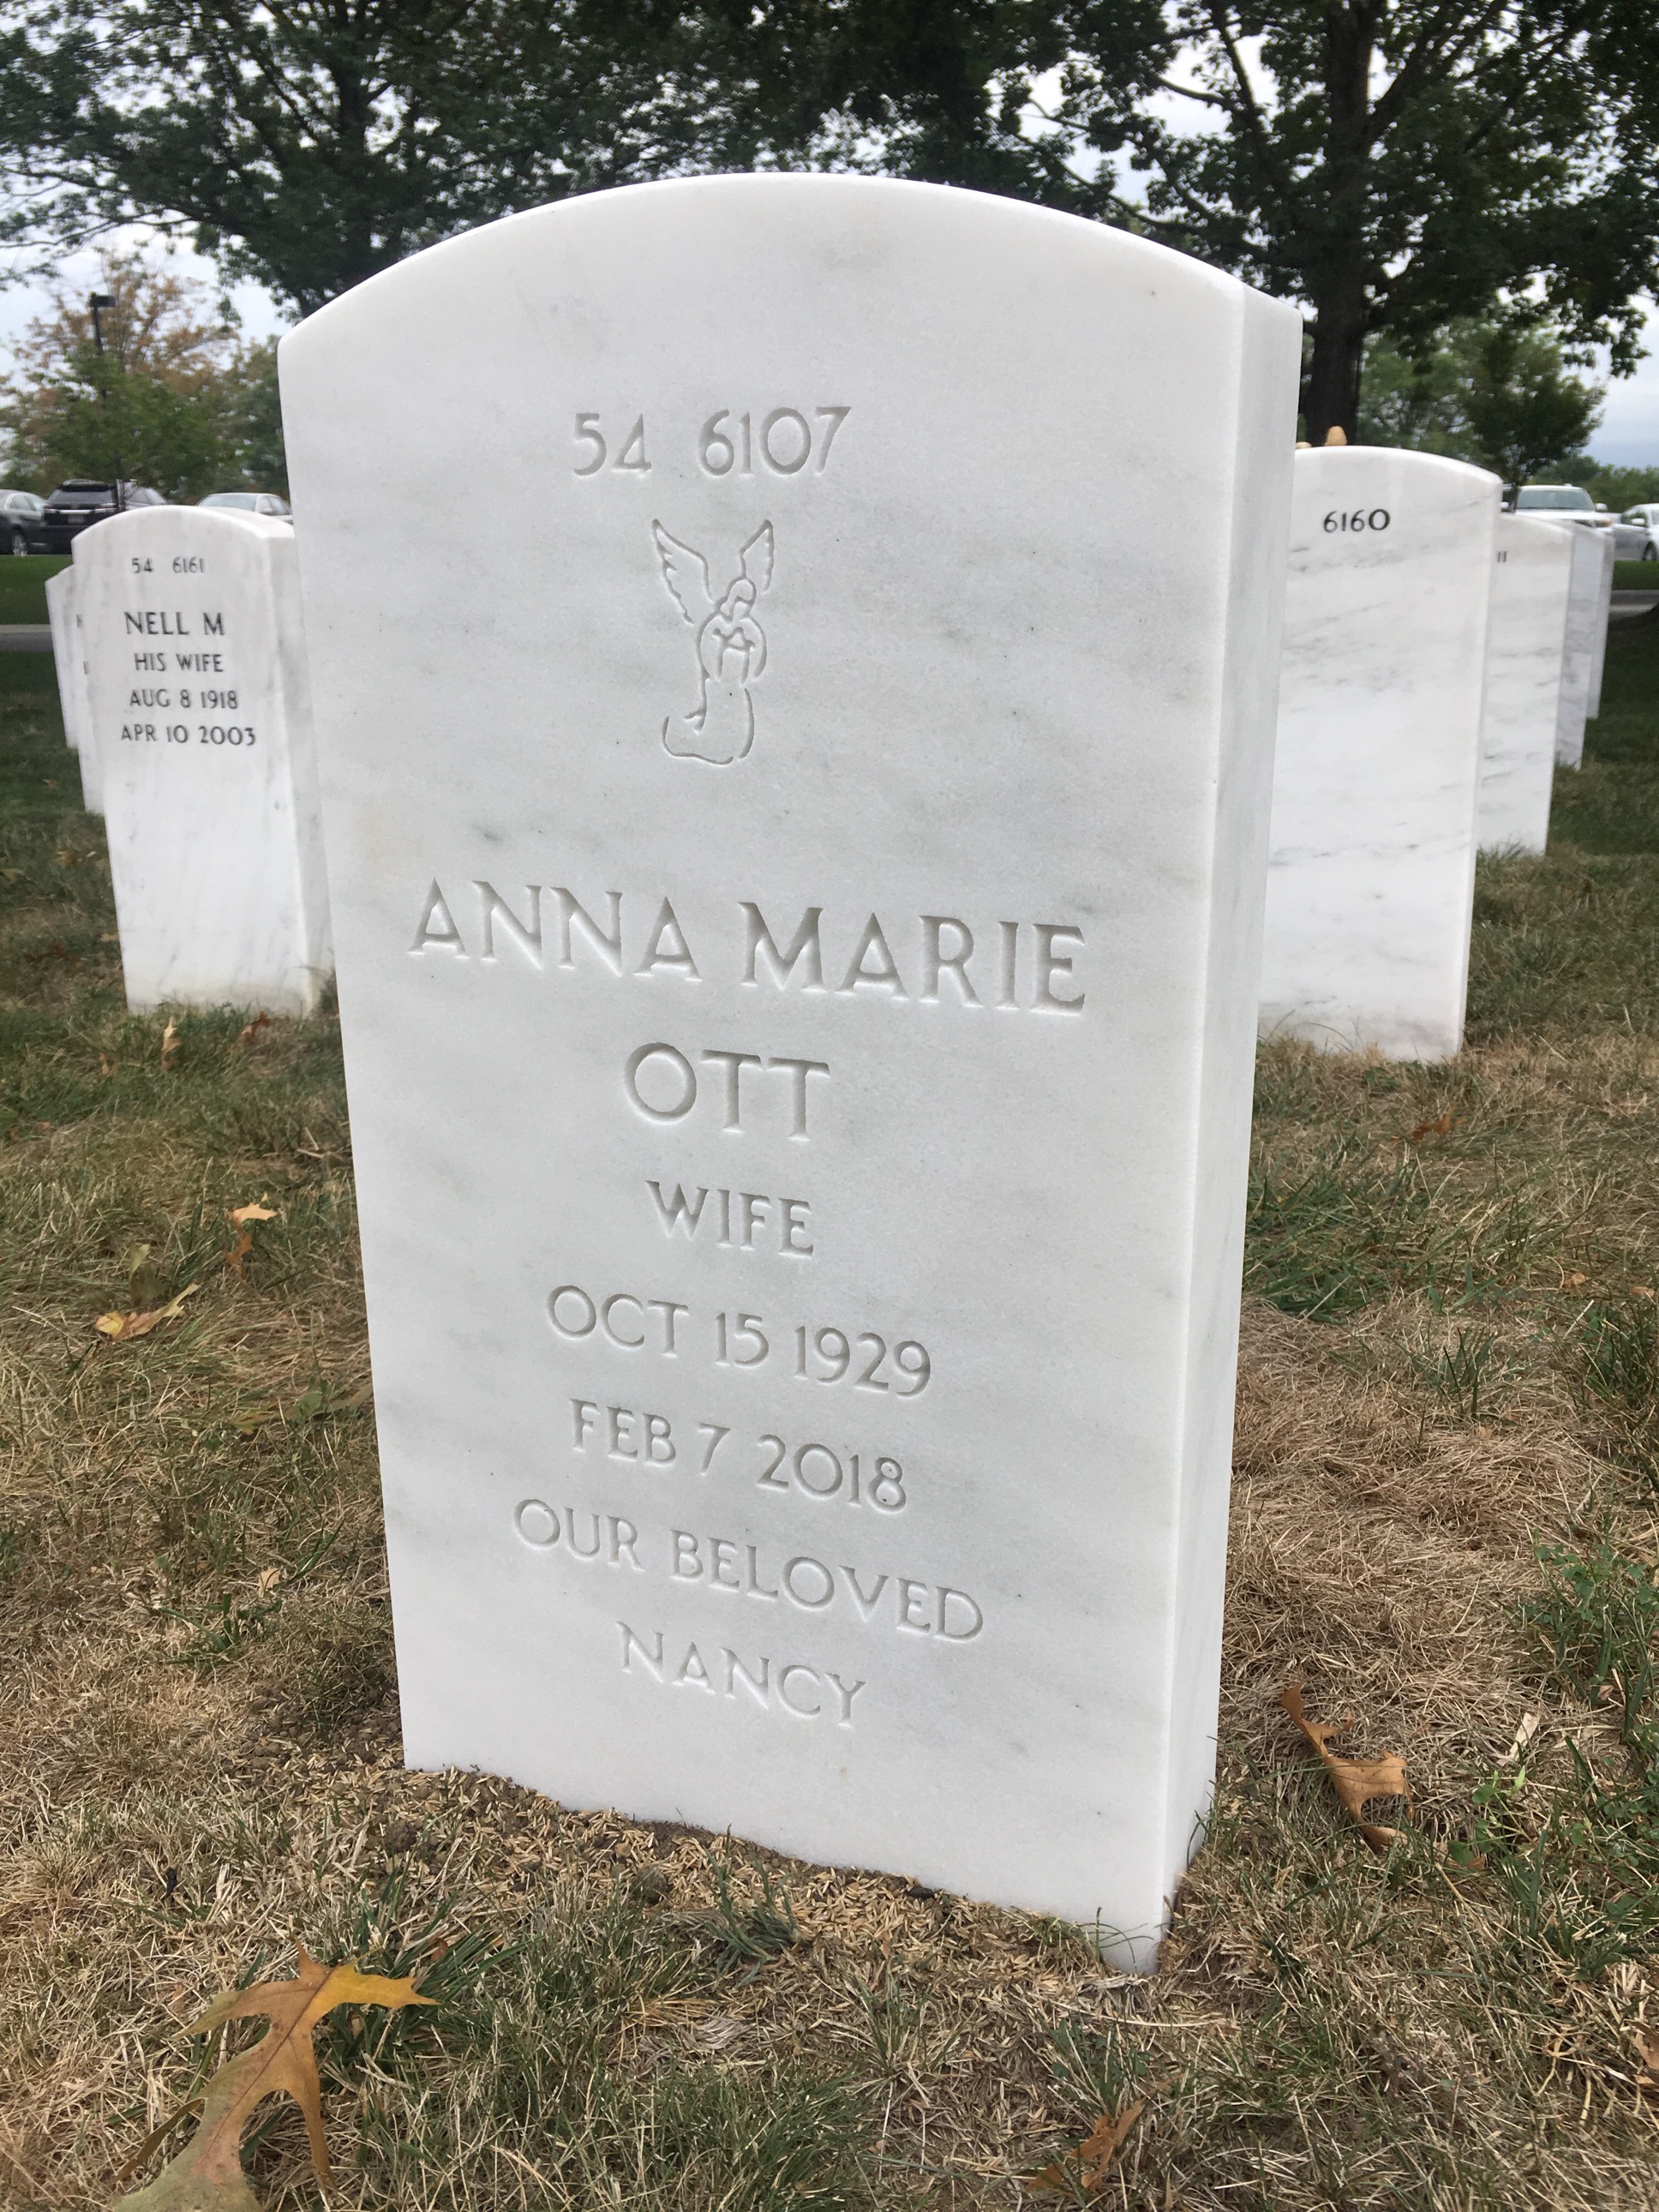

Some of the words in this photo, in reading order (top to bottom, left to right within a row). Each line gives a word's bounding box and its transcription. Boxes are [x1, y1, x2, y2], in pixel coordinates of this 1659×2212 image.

[573, 412, 652, 477] 54
[698, 406, 851, 477] 6107
[1322, 508, 1391, 533] 6160
[131, 557, 154, 573] 54
[172, 557, 205, 573] 6161
[123, 611, 189, 635] NELL
[203, 611, 225, 636] M
[129, 689, 170, 708] AUG
[180, 689, 191, 709] 8
[201, 690, 239, 710] 1918
[134, 652, 166, 672] HIS
[176, 653, 225, 673] WIFE
[121, 724, 158, 742] APR
[166, 725, 188, 744] 10
[199, 726, 255, 746] 2003
[406, 877, 704, 984] ANNA
[737, 900, 1086, 1016] MARIE
[623, 1041, 830, 1142] OTT
[644, 1180, 814, 1258] WIFE
[546, 1285, 689, 1358] OCT
[714, 1311, 770, 1370] 15
[794, 1325, 931, 1399] 1929
[570, 1399, 676, 1467] FEB
[698, 1423, 731, 1476] 7
[757, 1434, 907, 1514] 2018
[514, 1498, 645, 1572] OUR
[670, 1529, 984, 1643] BELOVED
[615, 1622, 867, 1728] NANCY
